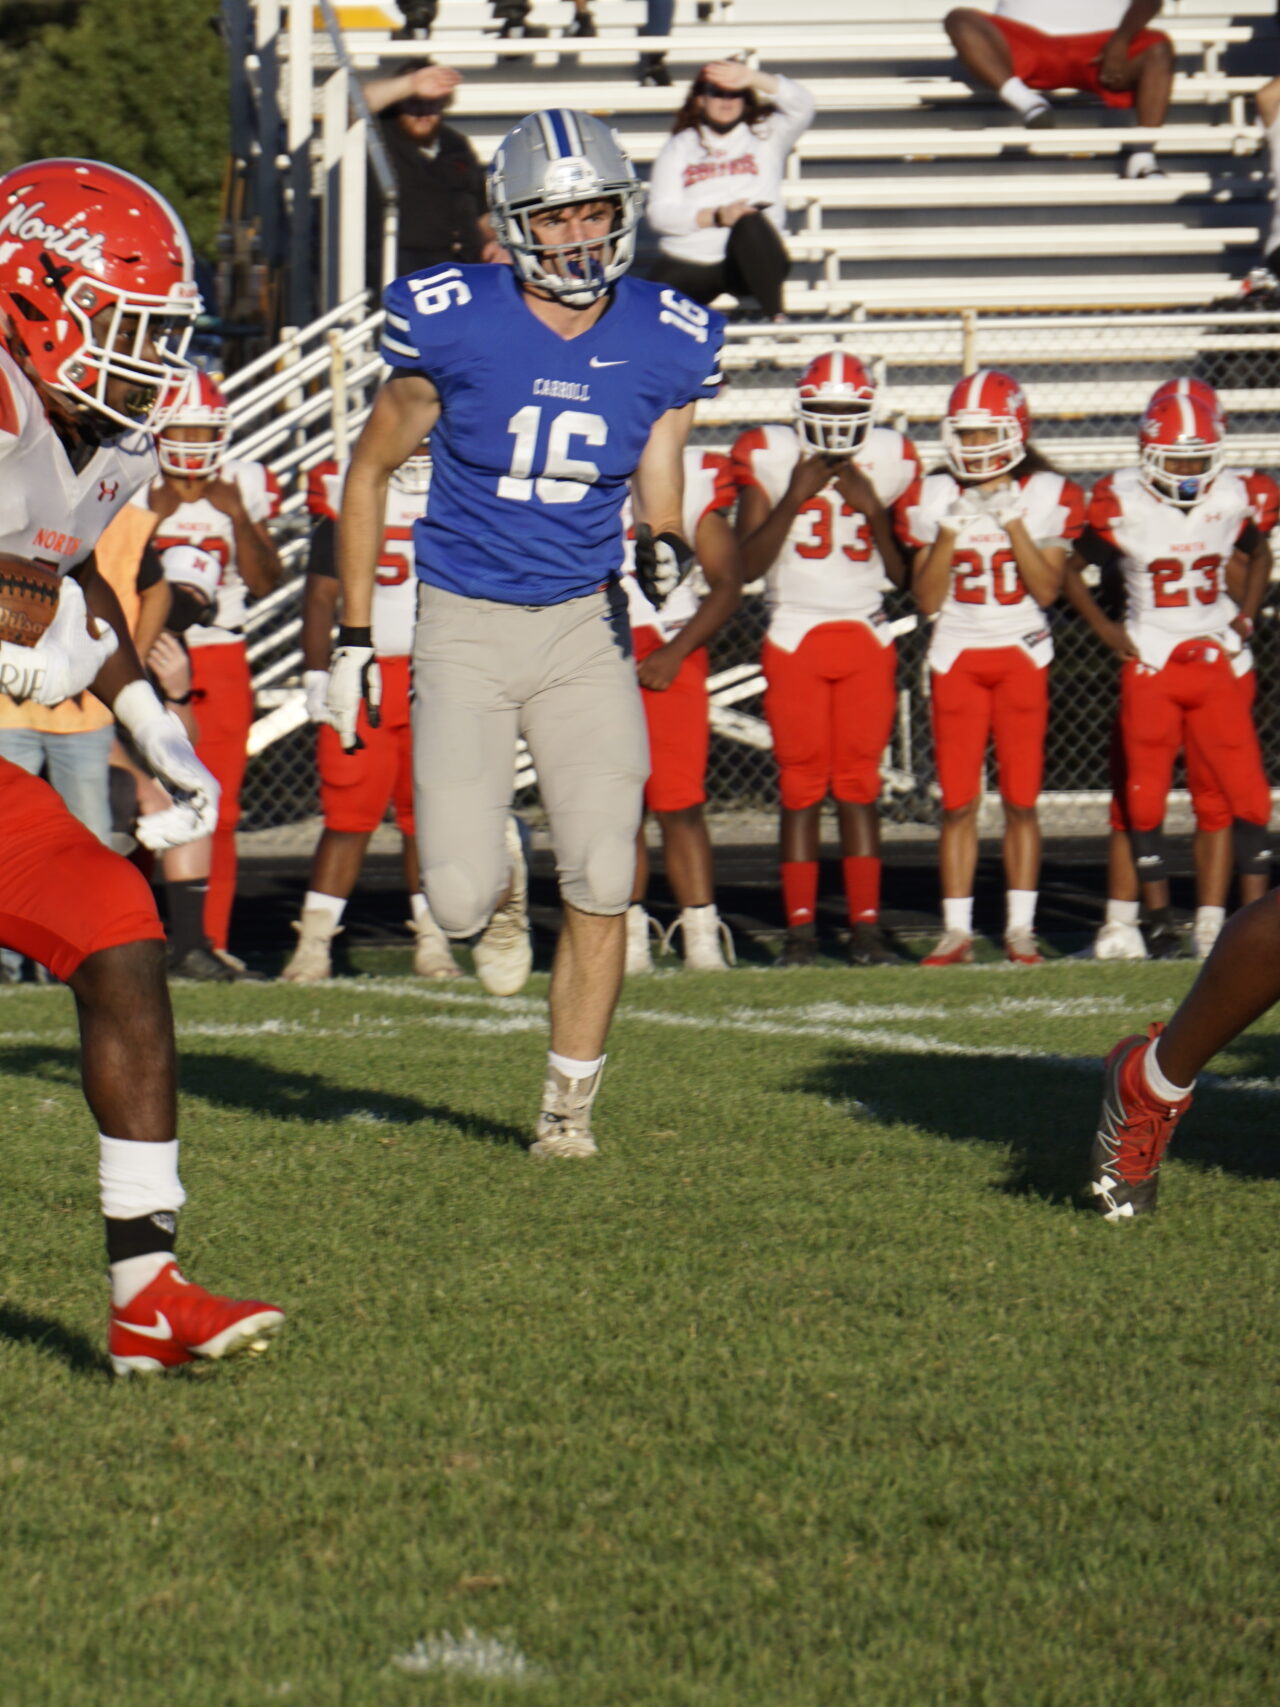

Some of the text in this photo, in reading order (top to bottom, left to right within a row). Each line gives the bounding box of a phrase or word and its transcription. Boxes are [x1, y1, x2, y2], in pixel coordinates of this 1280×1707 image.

[406, 267, 473, 316] 16
[658, 289, 710, 344] 16
[532, 377, 591, 402] CARROLL
[496, 404, 609, 504] 16
[31, 527, 82, 556] NORTH
[793, 497, 875, 562] 33
[950, 548, 1030, 606] 20
[1147, 553, 1221, 609] 23
